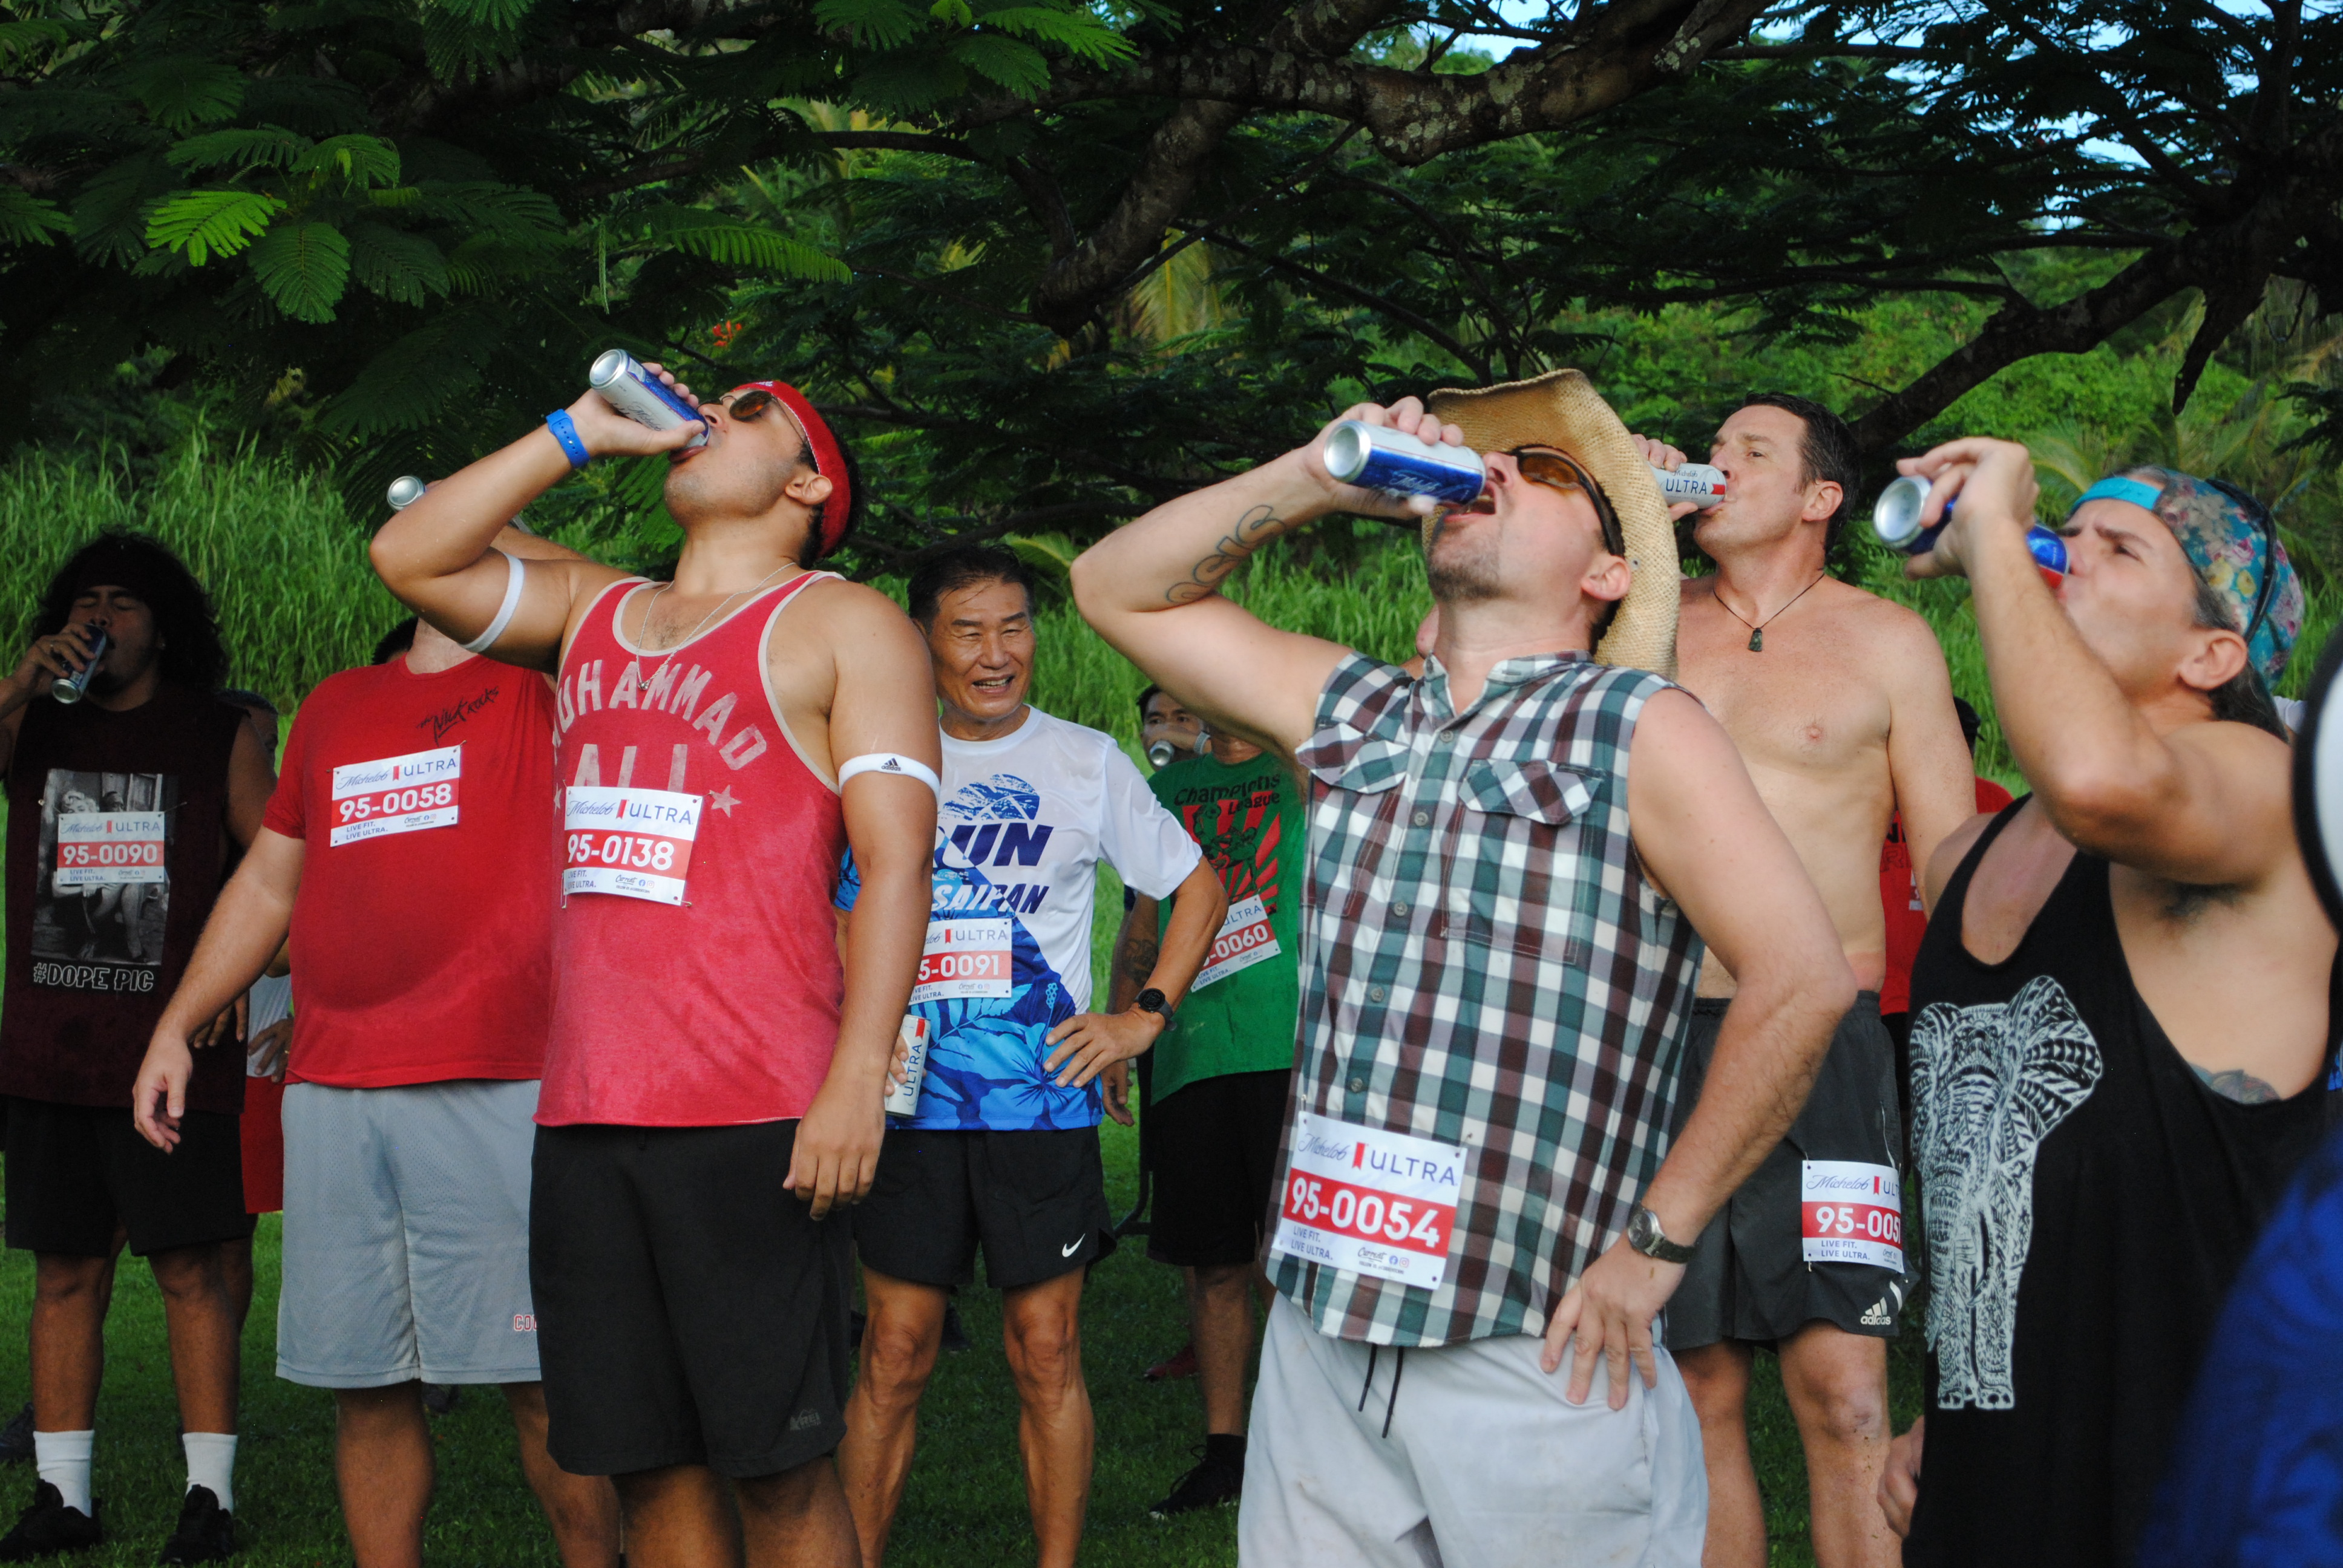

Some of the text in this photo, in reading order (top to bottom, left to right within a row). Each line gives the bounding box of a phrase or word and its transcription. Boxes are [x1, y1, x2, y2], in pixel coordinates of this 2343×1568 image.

[1666, 479, 1707, 495] ULTRA
[336, 758, 456, 790] Michelob ULTRA
[339, 783, 451, 823] 95-0058
[566, 800, 692, 825] Michelob ULTRA
[61, 822, 160, 834] Michelob ULTRA
[346, 827, 388, 840] LIVE ULTRA.
[347, 822, 375, 832] LIVE FIT.
[63, 844, 157, 864] 95-0090
[568, 834, 674, 871] 95-0138
[576, 880, 596, 888] ULTRA.
[932, 883, 1050, 914] SAIPAN
[955, 930, 1008, 941] ULTRA
[1204, 924, 1268, 966] -0060
[33, 962, 154, 992] #DOPE PIC
[918, 955, 999, 981] 5-0091
[1200, 976, 1211, 985] LIVE
[903, 1043, 922, 1097] ULTRA
[1298, 1133, 1456, 1186] Michelob ULTRA
[1806, 1175, 1899, 1197] Michelob ULT
[1291, 1177, 1440, 1248] 95-0054
[1293, 1225, 1320, 1242] LIVE FIT.
[1291, 1240, 1333, 1260] LIVE ULTRA.
[1842, 1250, 1870, 1260] ULTRA.
[1860, 1315, 1892, 1325] adidas
